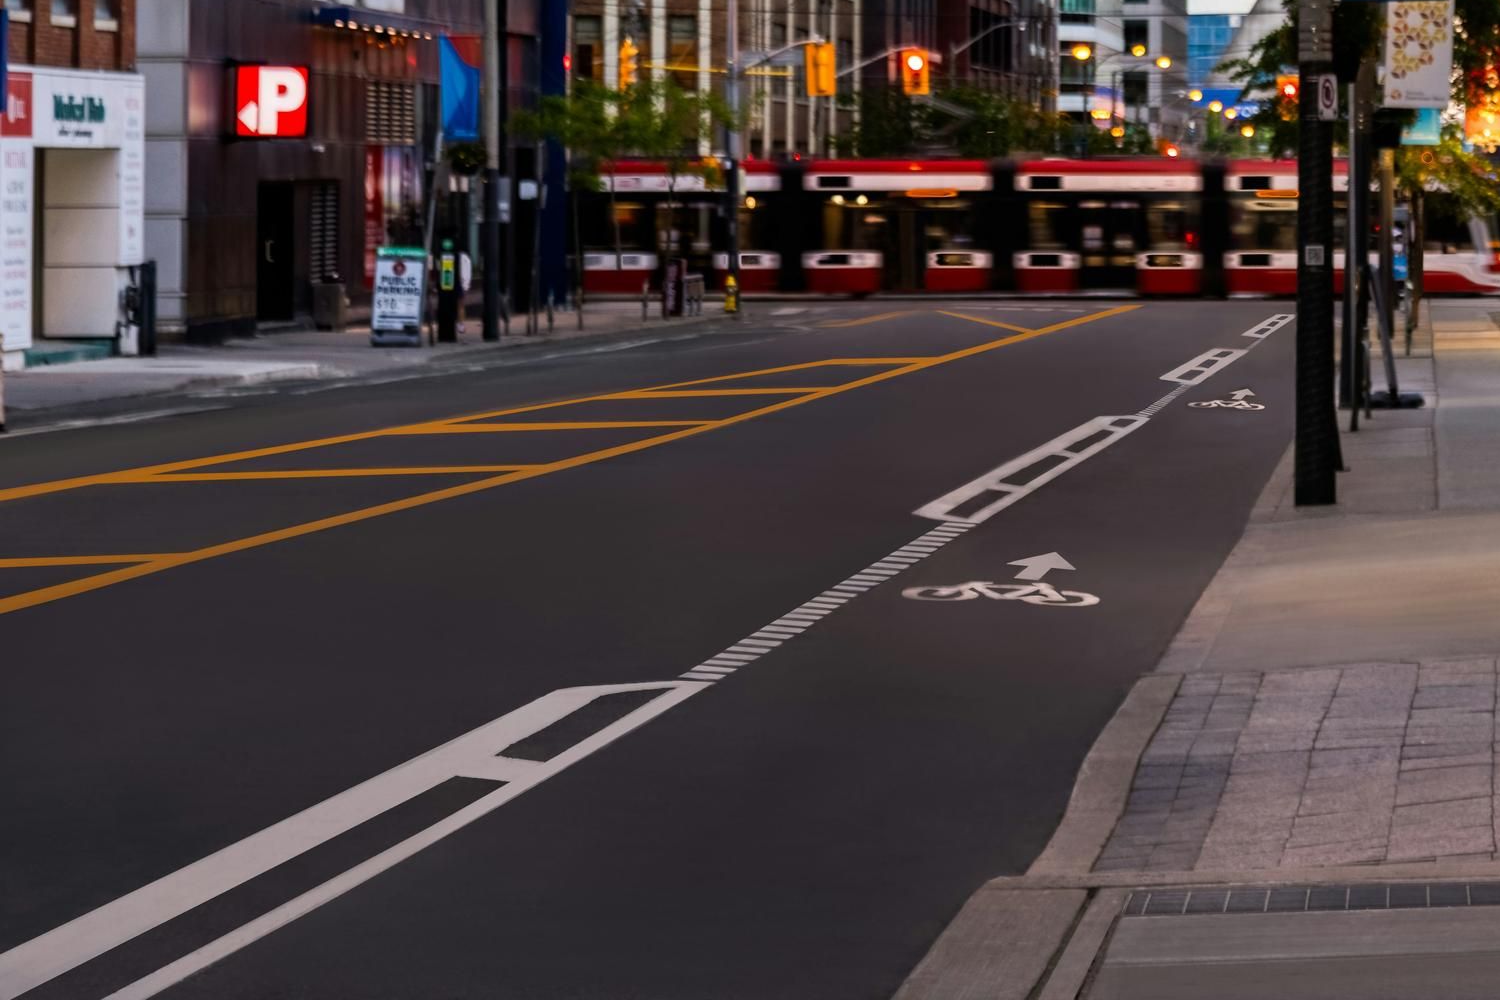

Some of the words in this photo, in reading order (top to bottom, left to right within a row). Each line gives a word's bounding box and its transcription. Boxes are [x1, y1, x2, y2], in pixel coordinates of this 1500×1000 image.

[258, 66, 307, 136] P
[381, 275, 417, 286] PUBLIC
[377, 285, 421, 296] PARKING
